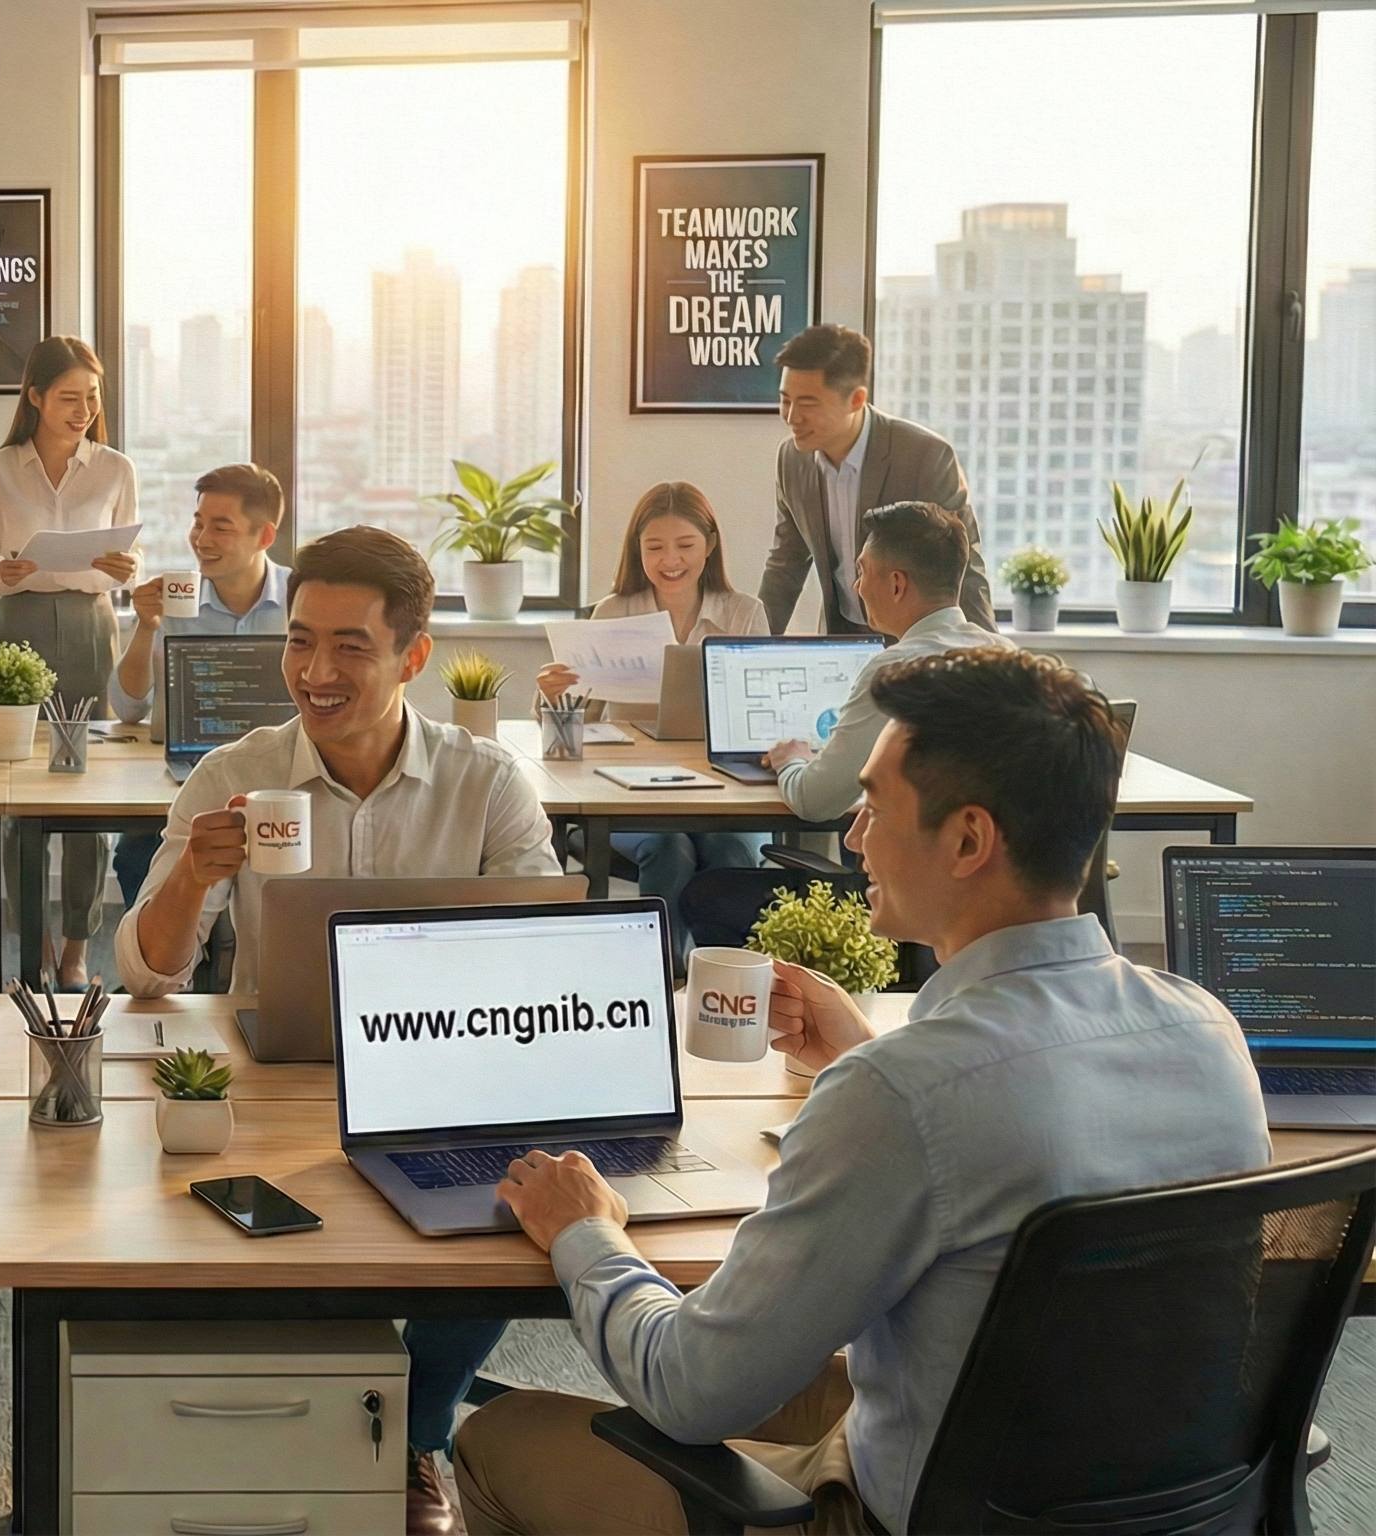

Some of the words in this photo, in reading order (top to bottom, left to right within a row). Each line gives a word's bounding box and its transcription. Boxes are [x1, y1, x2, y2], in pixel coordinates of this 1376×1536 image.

[657, 206, 799, 238] TEAMWORK
[685, 239, 769, 269] MAKES
[706, 270, 745, 293] THE
[669, 294, 782, 334] DREAM
[688, 335, 761, 367] WORK
[257, 821, 300, 838] CNG
[702, 990, 756, 1015] CNG
[360, 992, 650, 1045] www.cngnib.cn
